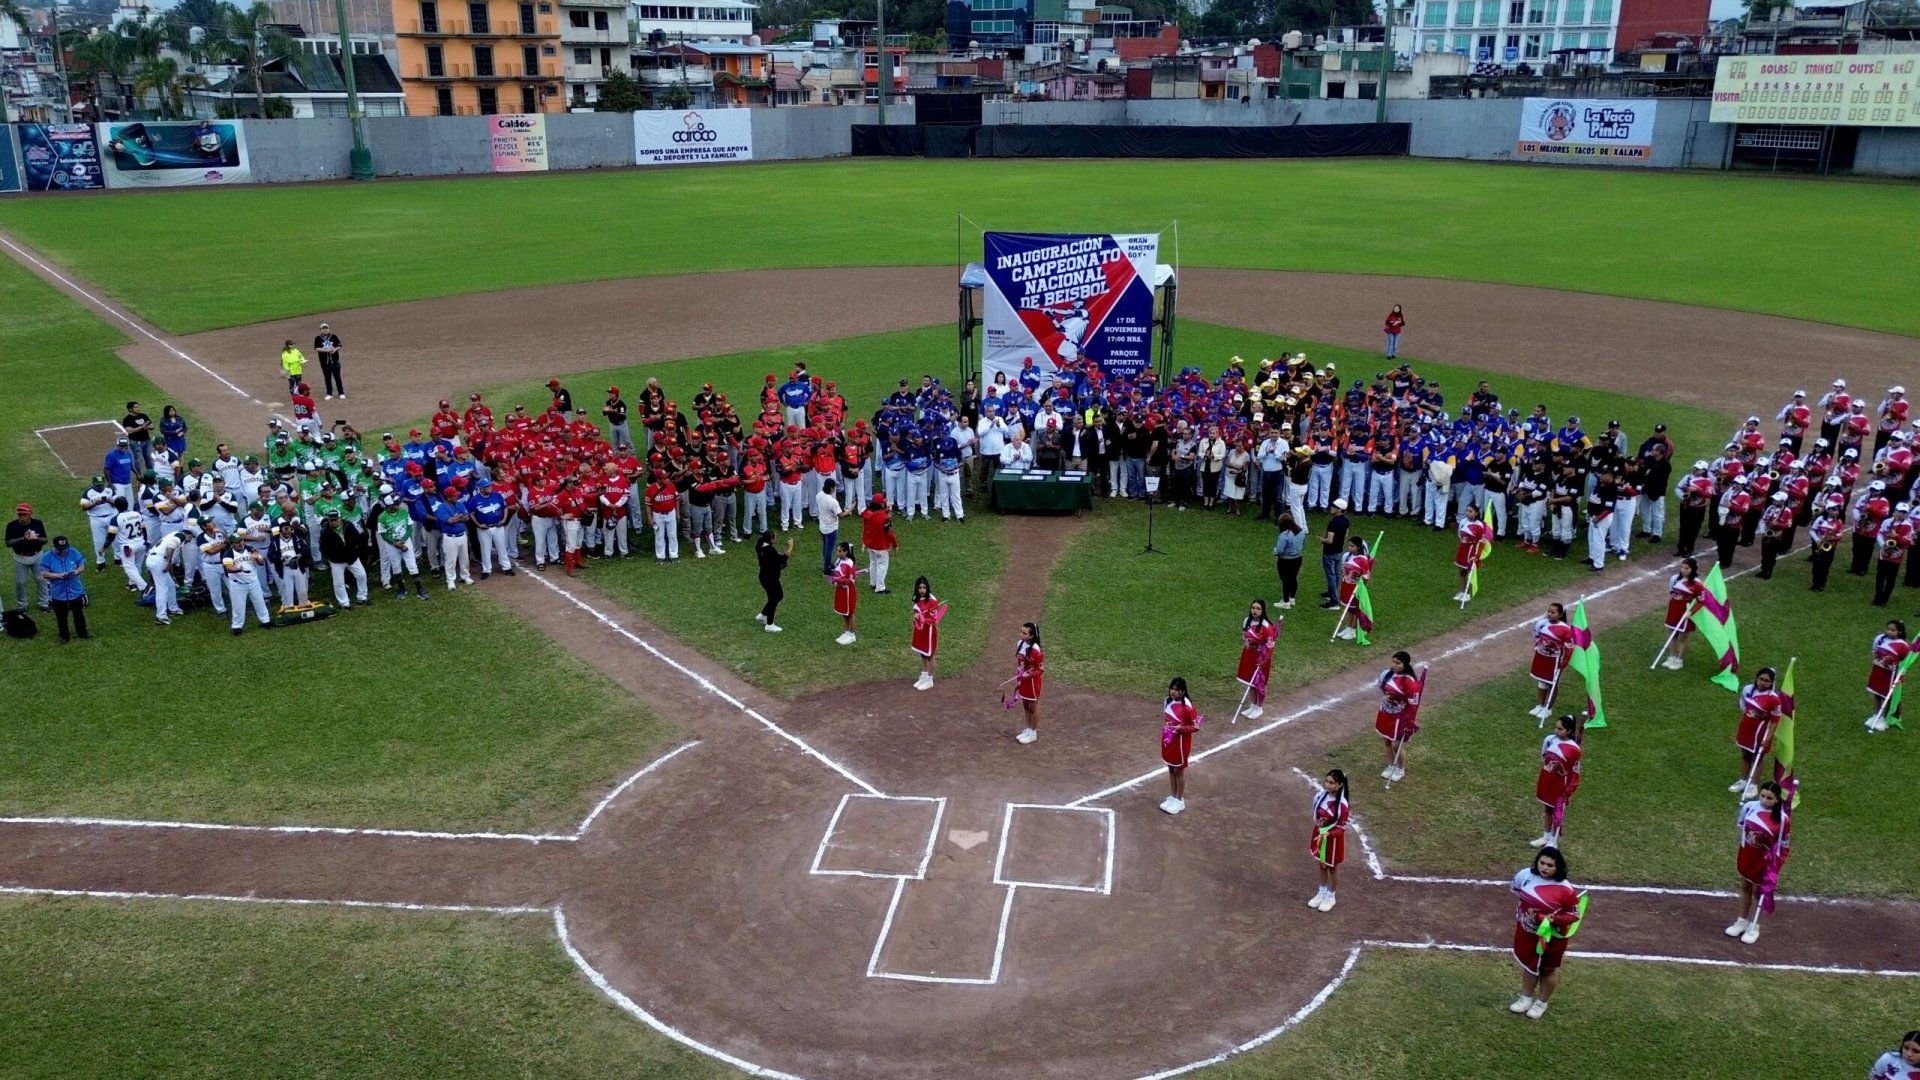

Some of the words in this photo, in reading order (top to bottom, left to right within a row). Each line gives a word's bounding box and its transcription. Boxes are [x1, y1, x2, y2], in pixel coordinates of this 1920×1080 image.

[1760, 64, 1788, 74] BOLAS
[1804, 64, 1833, 74] STRIKES
[1849, 64, 1874, 74] OUTS
[1882, 82, 1889, 90] H
[1714, 92, 1740, 102] VISITA
[1585, 108, 1601, 122] La
[1602, 109, 1634, 124] Vaca
[498, 119, 531, 128] Caldos
[1589, 122, 1629, 139] Pinta
[1523, 145, 1536, 153] LOS
[1539, 145, 1570, 154] MEJORES
[1575, 147, 1595, 155] TACOS
[1600, 147, 1609, 155] DE
[1613, 148, 1643, 157] XALAPA
[997, 236, 1104, 270] INAUGURACIÓN
[1011, 247, 1121, 283] CAMPEONATO
[1025, 266, 1107, 296] NACIONAL
[1020, 294, 1040, 308] DE
[1044, 280, 1110, 308] BEISBOL
[125, 521, 143, 539] 23
